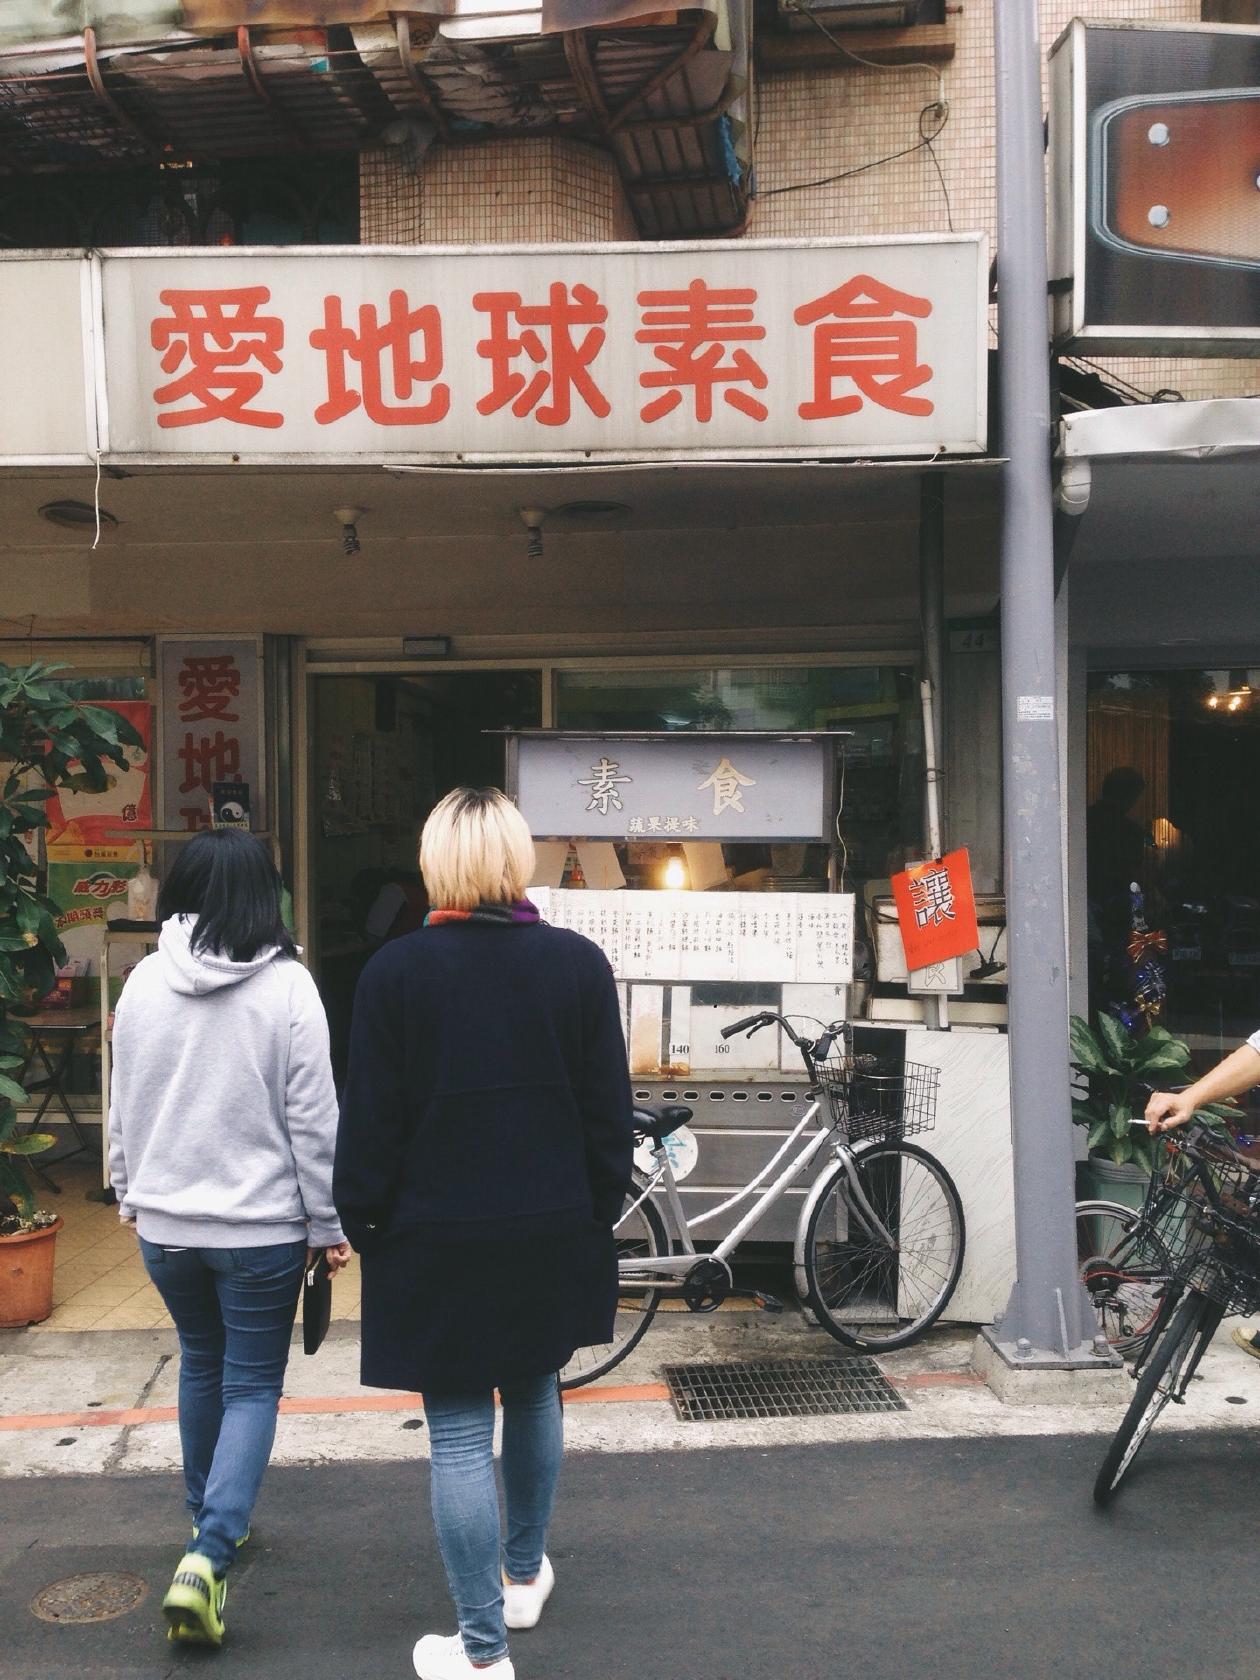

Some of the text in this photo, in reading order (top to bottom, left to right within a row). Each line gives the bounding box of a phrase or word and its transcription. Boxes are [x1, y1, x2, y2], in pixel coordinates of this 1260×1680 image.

[150, 273, 934, 428] 愛地球素食
[578, 758, 756, 816] 素食
[909, 867, 957, 929] 讓
[671, 1044, 690, 1054] 140
[714, 1044, 730, 1054] 160
